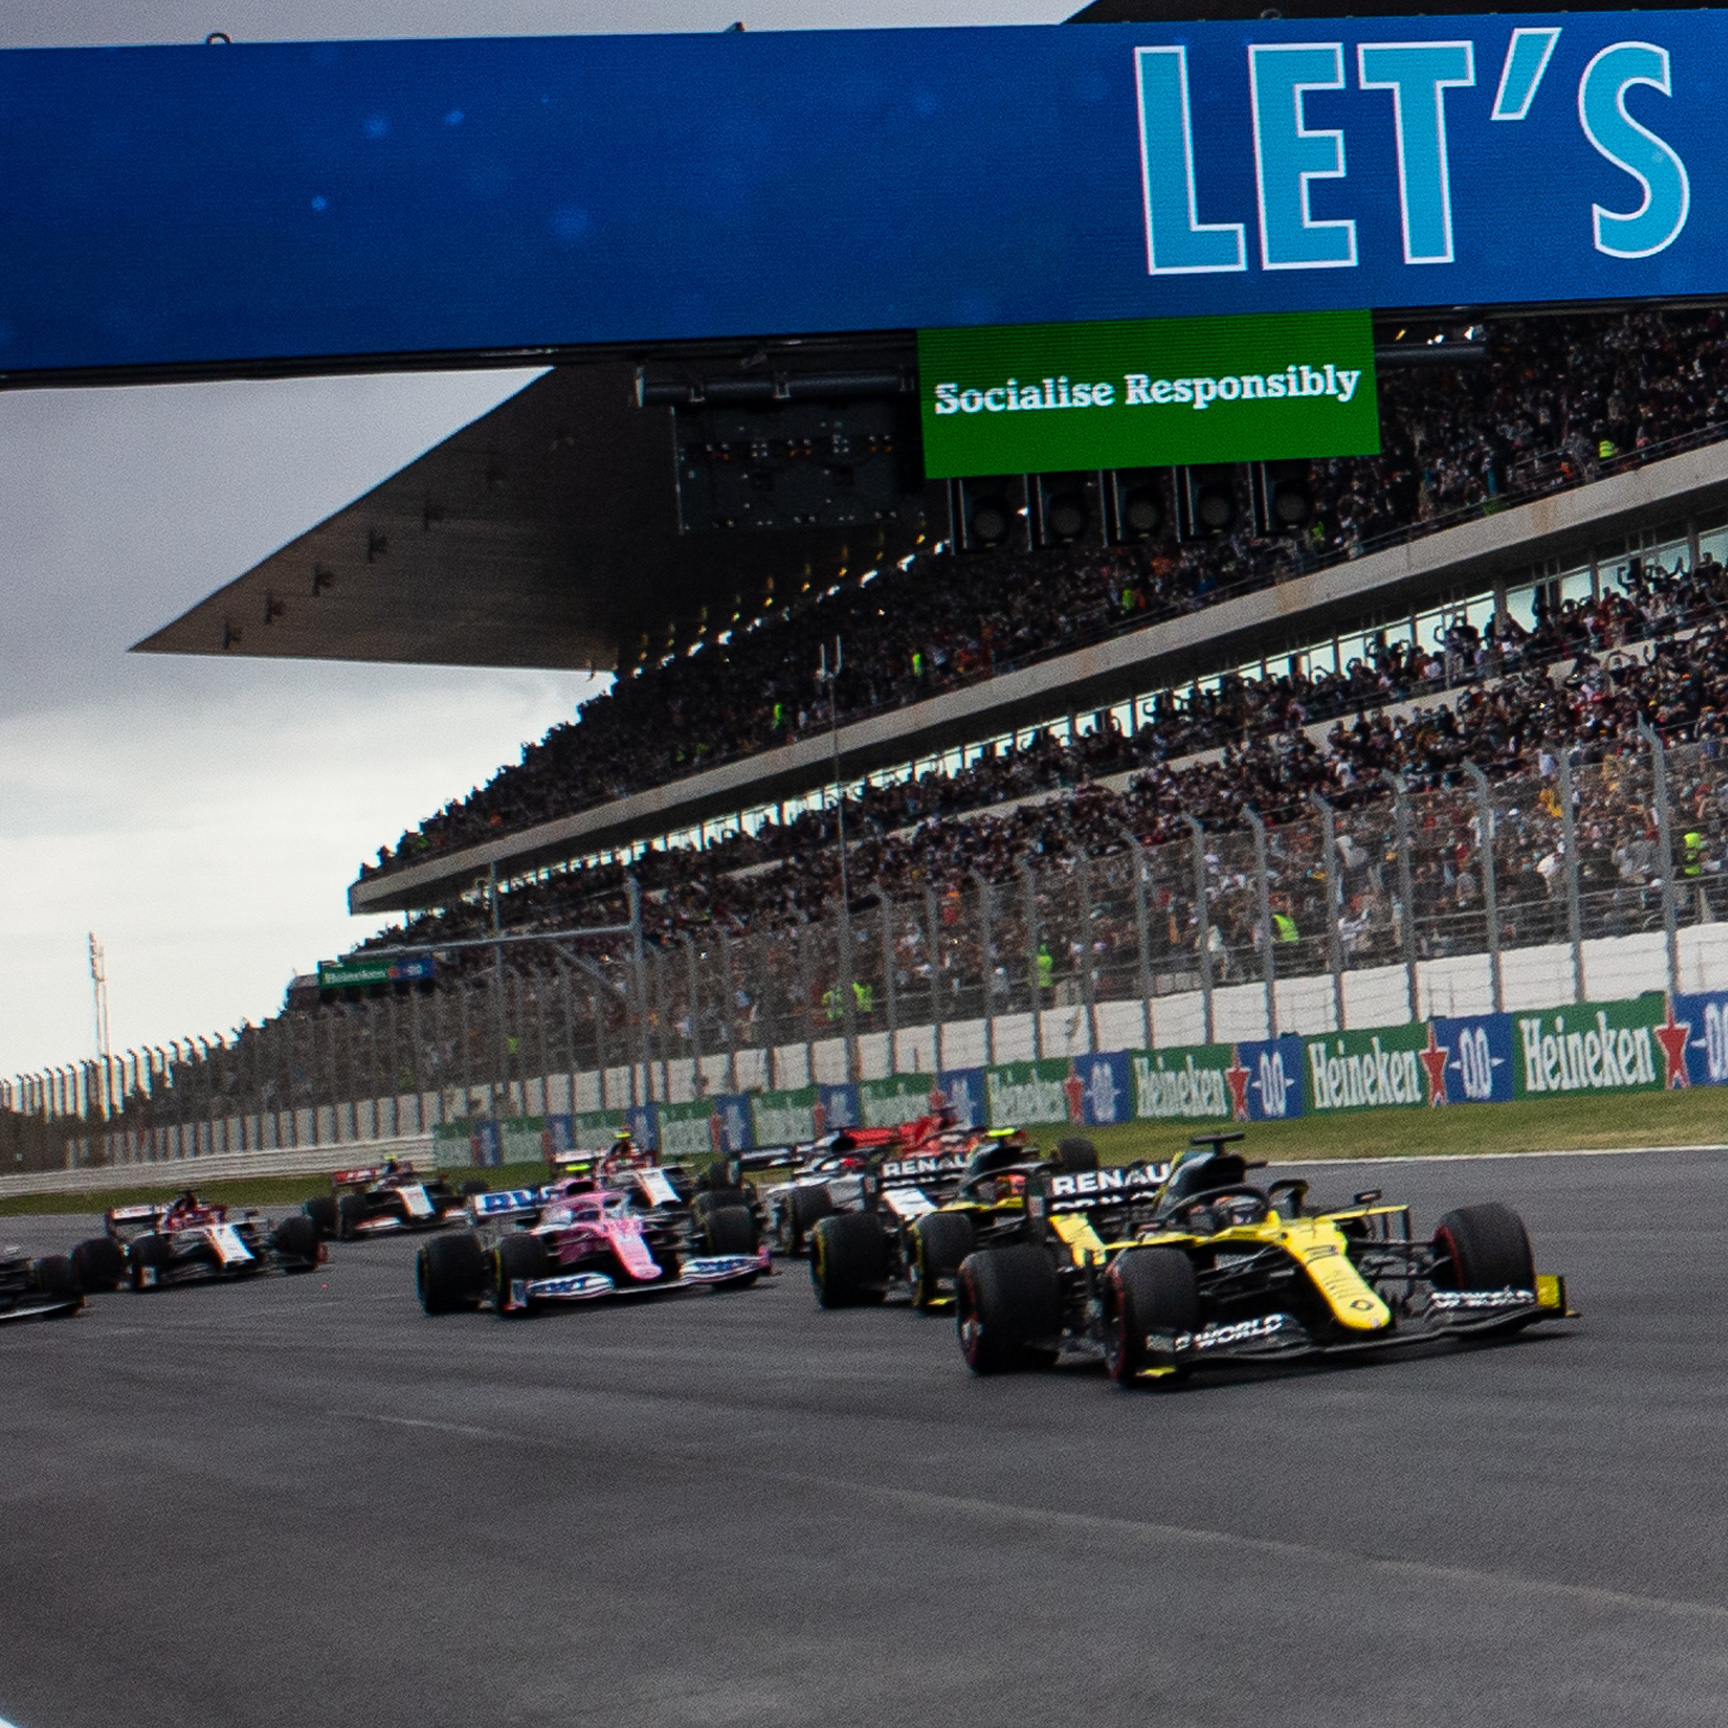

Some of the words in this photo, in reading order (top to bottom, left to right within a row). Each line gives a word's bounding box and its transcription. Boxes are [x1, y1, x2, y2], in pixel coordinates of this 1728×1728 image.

[1134, 27, 1691, 275] LET'S
[934, 380, 1114, 415] Socialise
[1124, 364, 1362, 409] Responsibly
[1307, 1036, 1424, 1107] Heineken
[1519, 1010, 1657, 1092] Heineken
[1133, 1053, 1229, 1119] Heineken
[882, 1149, 966, 1177] RENAU
[1051, 1163, 1172, 1196] RENAU
